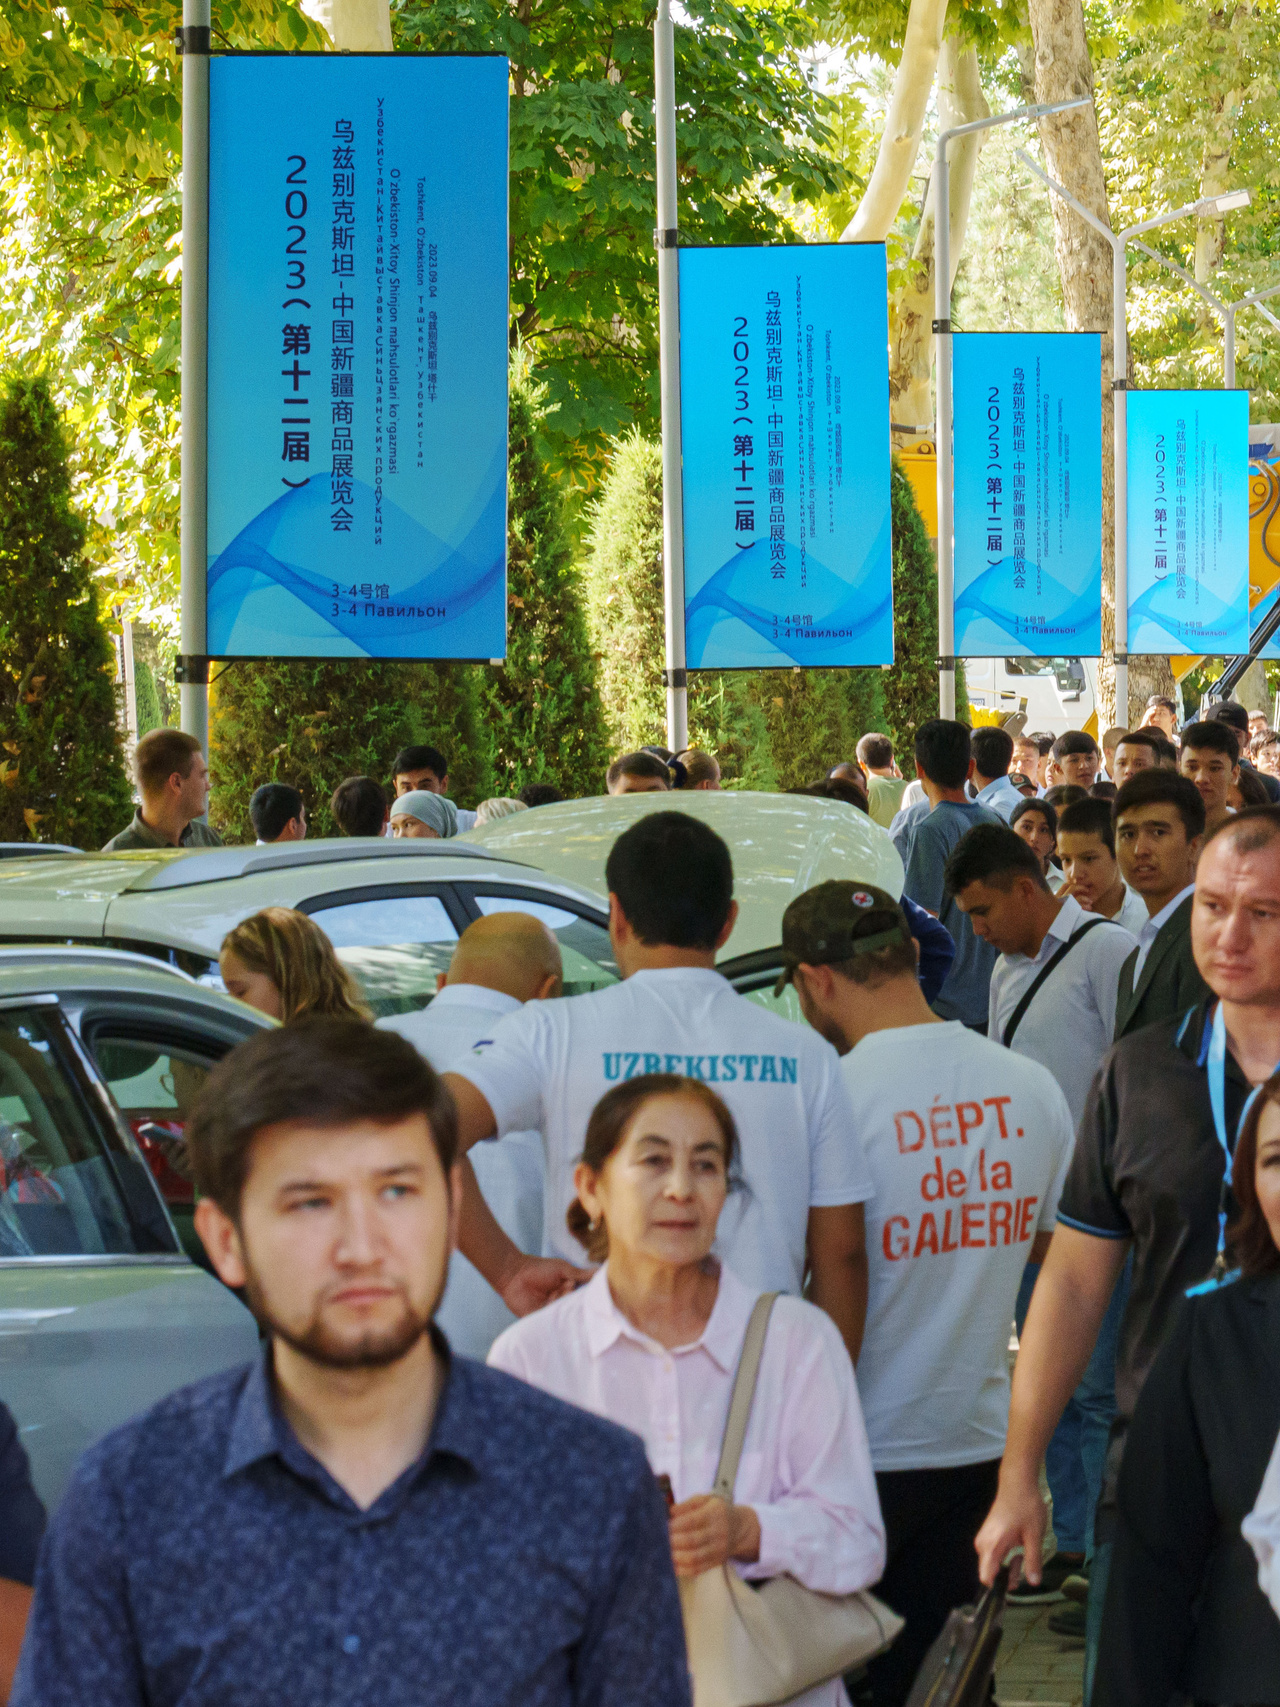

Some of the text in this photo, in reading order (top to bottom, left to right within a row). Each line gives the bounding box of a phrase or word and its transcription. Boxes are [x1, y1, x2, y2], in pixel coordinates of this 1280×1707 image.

[416, 176, 426, 224] Toshkent,
[428, 243, 438, 298] 2023.09.04
[387, 278, 400, 322] Shinjon
[388, 326, 400, 400] mahsulotlari
[416, 371, 425, 468] Узбекистан
[331, 583, 390, 599] 3-4号馆
[331, 602, 446, 618] 3-4 Павильон
[773, 629, 852, 639] 3-4 Павильон
[1032, 626, 1076, 635] Павильон
[602, 1052, 799, 1084] UZBEKISTAN
[894, 1094, 1025, 1154] DÉPT.
[920, 1148, 1013, 1202] de la
[882, 1196, 1039, 1262] GALERIE
